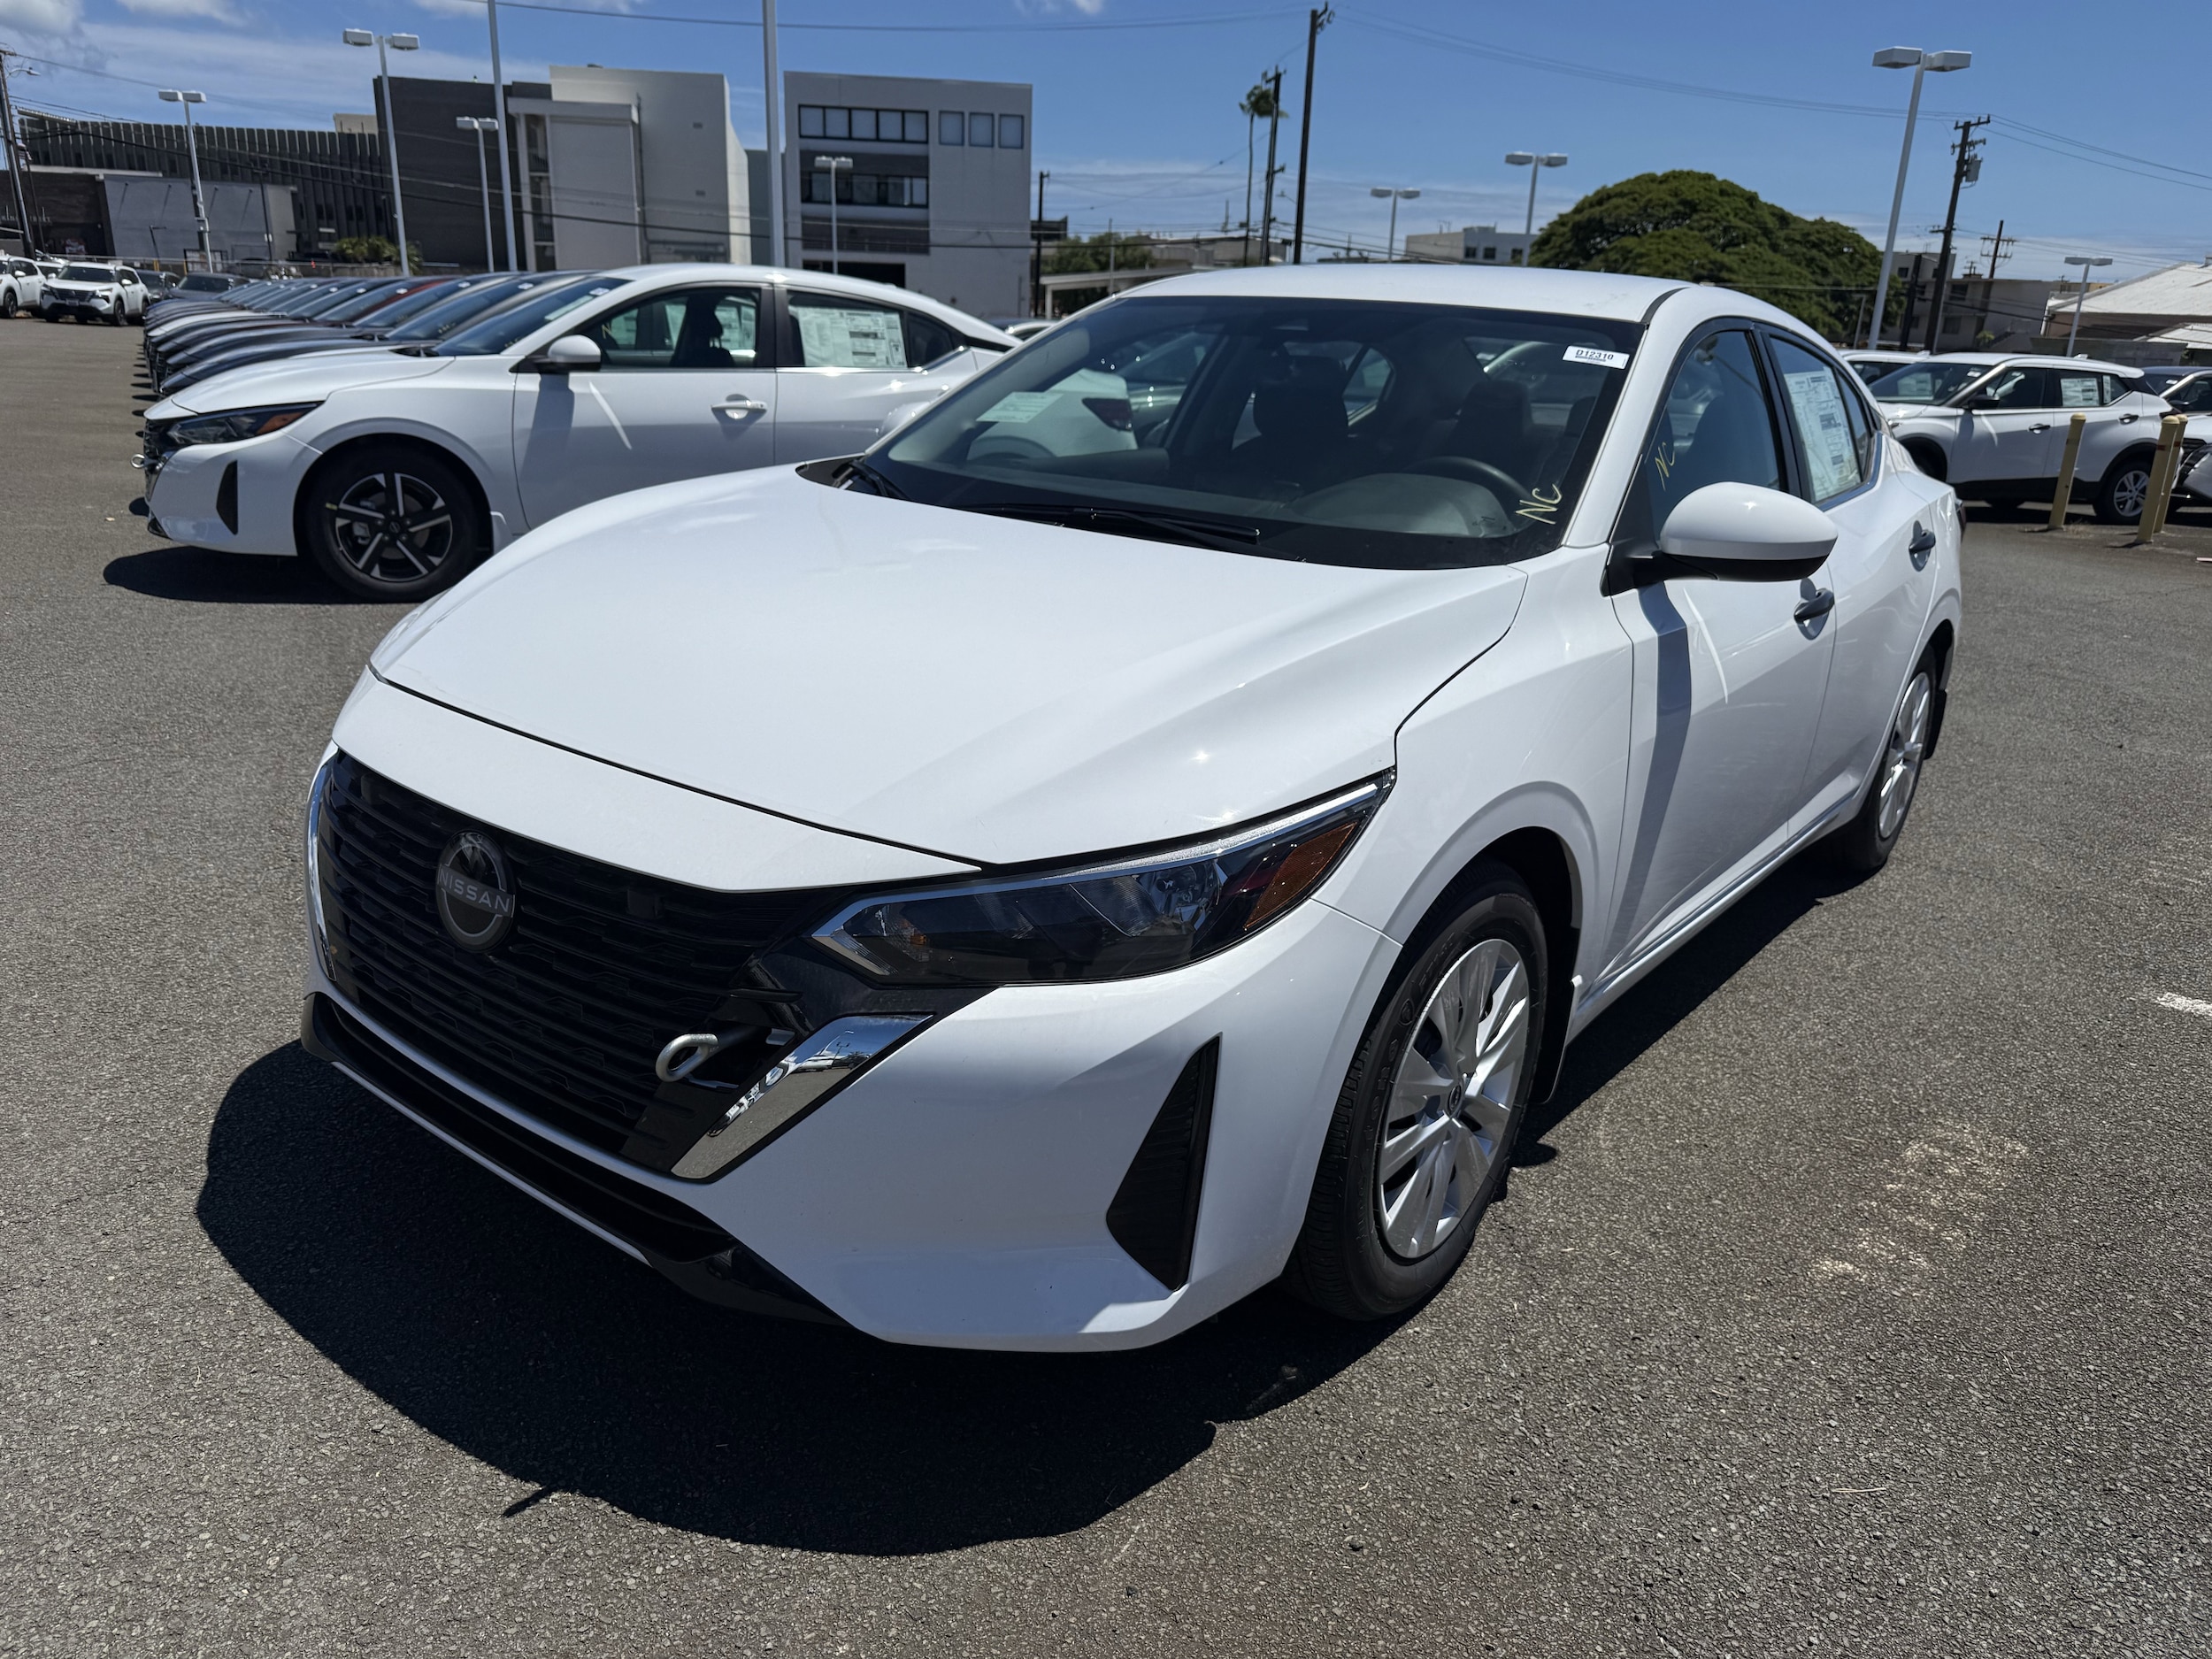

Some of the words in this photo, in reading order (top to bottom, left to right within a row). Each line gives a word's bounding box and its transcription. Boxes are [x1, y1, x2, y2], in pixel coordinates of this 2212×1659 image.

[1576, 349, 1614, 360] D12310
[1655, 442, 1676, 491] NC
[1516, 484, 1563, 525] NC
[440, 868, 510, 912] NISSAN
